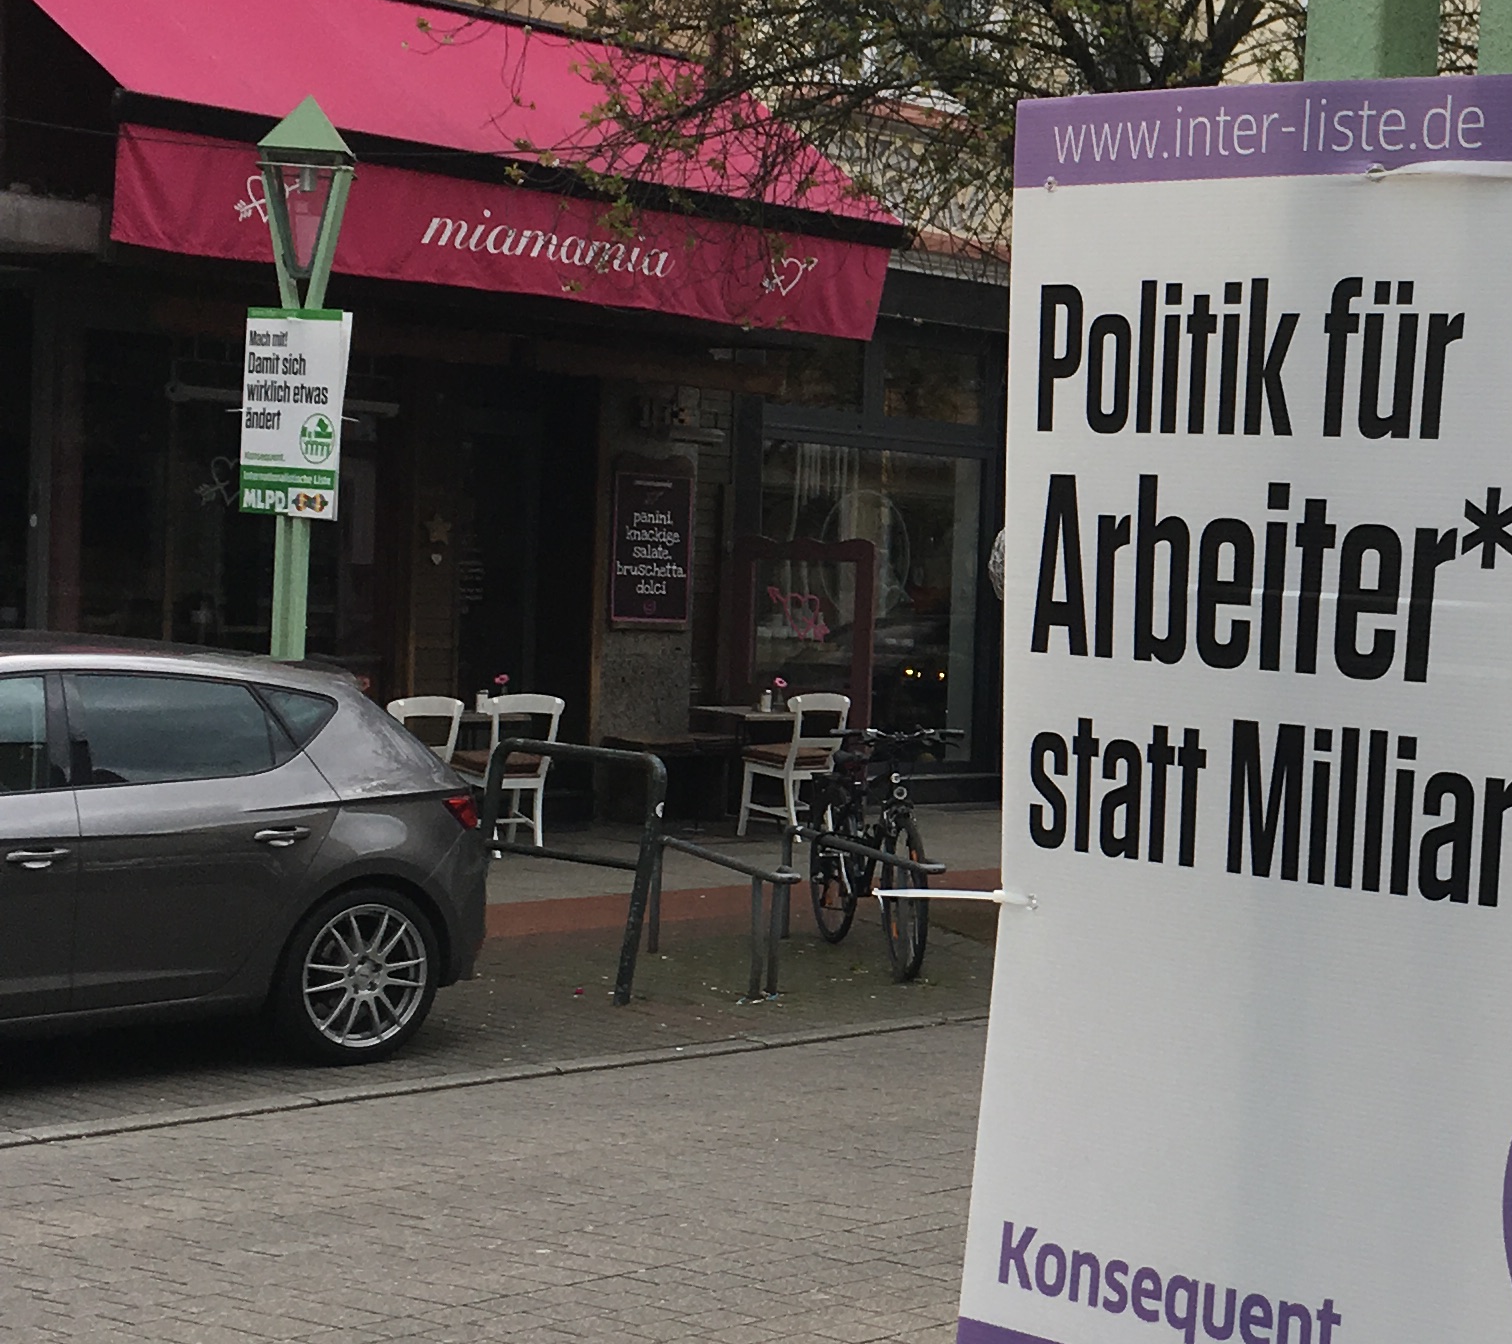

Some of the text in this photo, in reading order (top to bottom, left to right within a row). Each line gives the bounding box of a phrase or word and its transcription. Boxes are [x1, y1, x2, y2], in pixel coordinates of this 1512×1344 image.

[1053, 94, 1485, 164] www.inter-liste.de
[421, 208, 674, 280] miamamia
[249, 329, 288, 348] Mach mit!
[247, 351, 306, 376] Damit sich
[1036, 275, 1465, 440] Politik für
[246, 380, 328, 405] wirklich etwas
[245, 408, 281, 430] ändert
[243, 488, 286, 513] MLPD
[1028, 717, 1206, 868] statt
